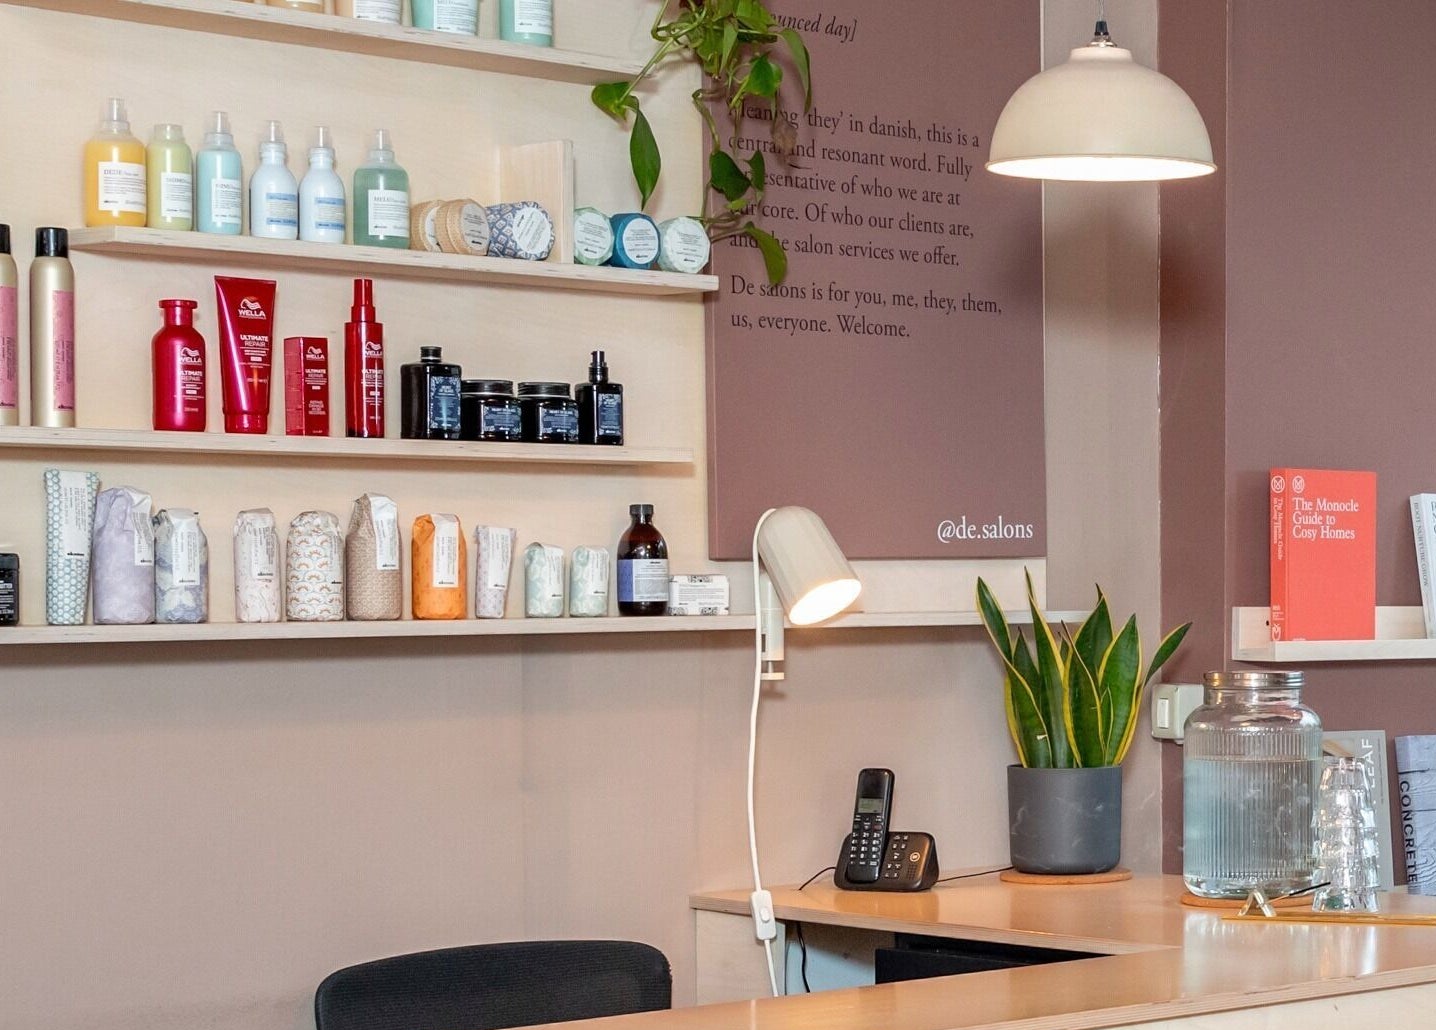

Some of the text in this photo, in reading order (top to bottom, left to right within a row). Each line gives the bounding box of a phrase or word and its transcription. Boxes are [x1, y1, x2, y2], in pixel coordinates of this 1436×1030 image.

[825, 16, 858, 43] day]
[849, 114, 863, 132] in
[869, 115, 922, 142] danish,
[927, 123, 953, 144] this
[957, 128, 968, 146] is
[972, 134, 980, 147] a
[728, 137, 783, 154] centra
[822, 146, 885, 166] resonant
[890, 152, 931, 172] word.
[938, 155, 973, 182] Fully
[745, 170, 961, 206] sentative of who we are at
[762, 205, 799, 220] core.
[805, 203, 828, 222] Of
[831, 206, 863, 226] who
[868, 214, 894, 229] our
[898, 211, 944, 234] clients
[949, 222, 974, 239] are,
[795, 234, 833, 255] salon
[839, 241, 894, 260] services
[900, 248, 920, 262] we
[923, 245, 959, 266] offer.
[731, 274, 1002, 315] De salons is for you, me, they, them,
[238, 309, 266, 317] WELLA
[731, 313, 910, 337] us, everyone. Welcome.
[240, 334, 268, 342] ULTIMATE
[1292, 498, 1359, 512] The Monocle
[1293, 512, 1336, 525] Guide to
[937, 515, 1033, 543] @de.salons
[1293, 526, 1355, 541] Cosy Homes
[1400, 781, 1418, 883] CONCRETE
